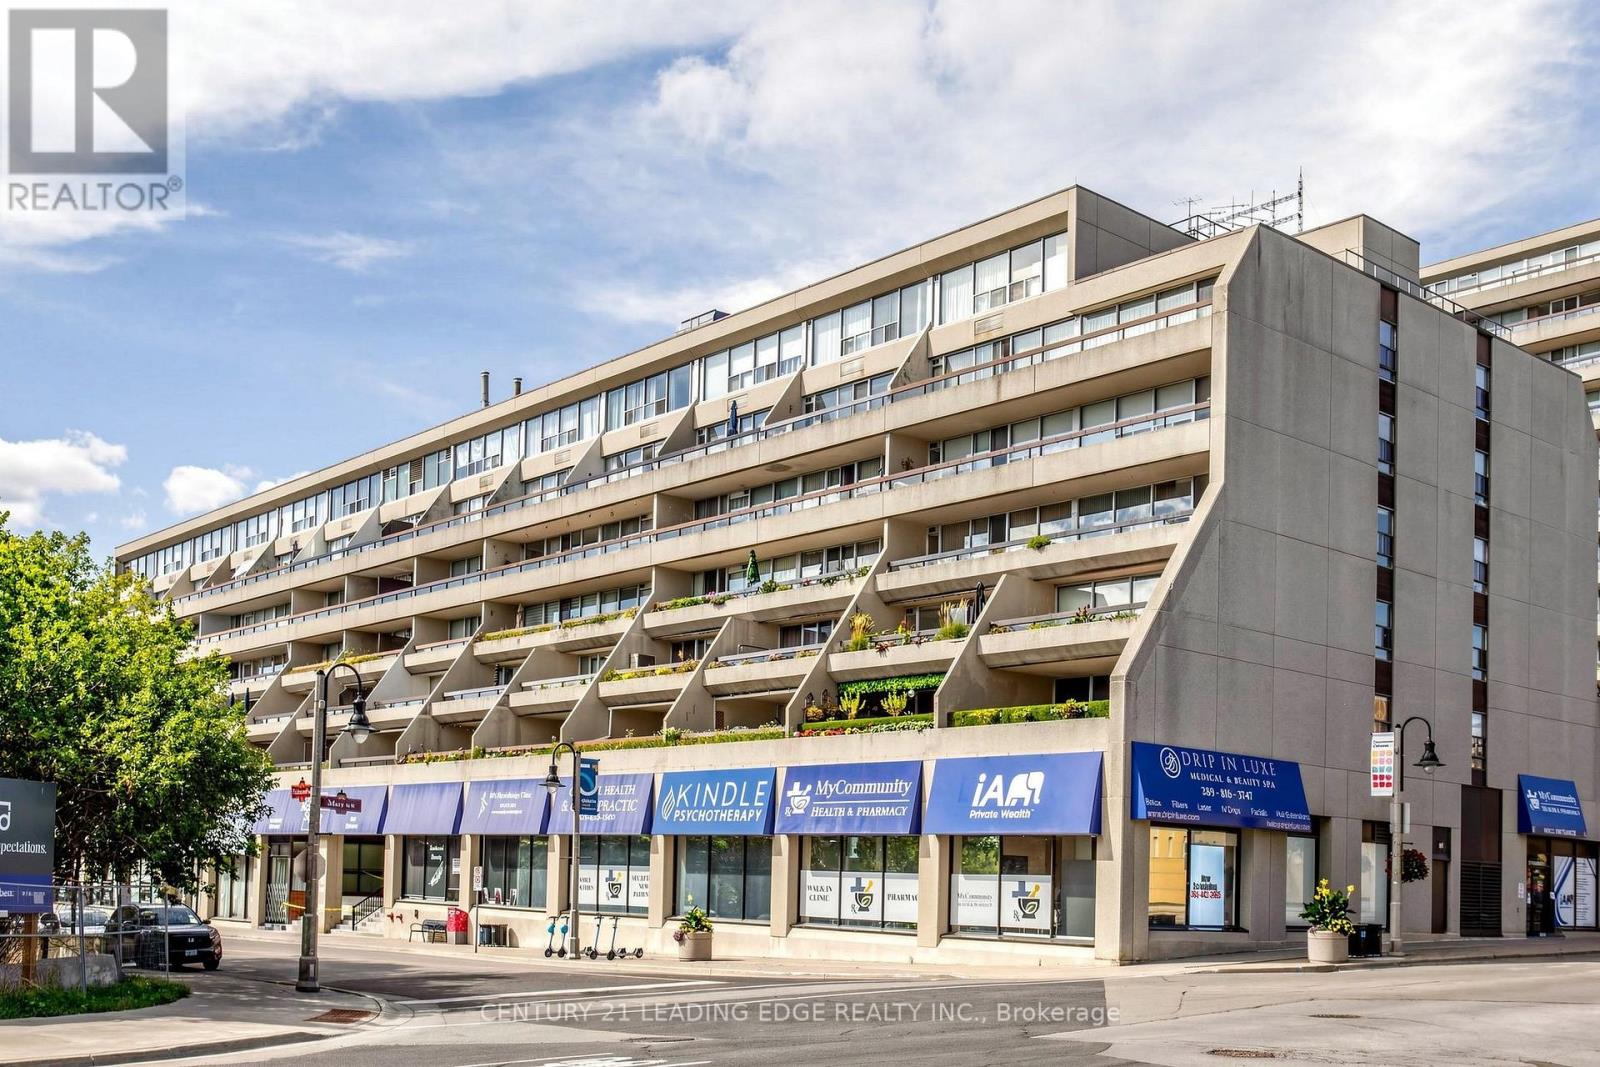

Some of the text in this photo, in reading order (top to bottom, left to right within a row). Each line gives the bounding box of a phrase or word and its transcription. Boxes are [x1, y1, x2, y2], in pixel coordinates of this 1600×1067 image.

[1181, 751, 1277, 776] DRIP IN LUXE
[1190, 772, 1224, 783] MEDICAL
[1234, 777, 1260, 787] BEAUTY
[1263, 780, 1275, 789] SPA
[604, 785, 636, 795] HEALTH
[676, 781, 768, 807] KINDLE
[815, 779, 912, 799] MyCommunity
[673, 809, 762, 822] PSYCHOTHERAPY
[811, 806, 908, 817] HEALTH & PHARMACY
[970, 809, 998, 819] Private
